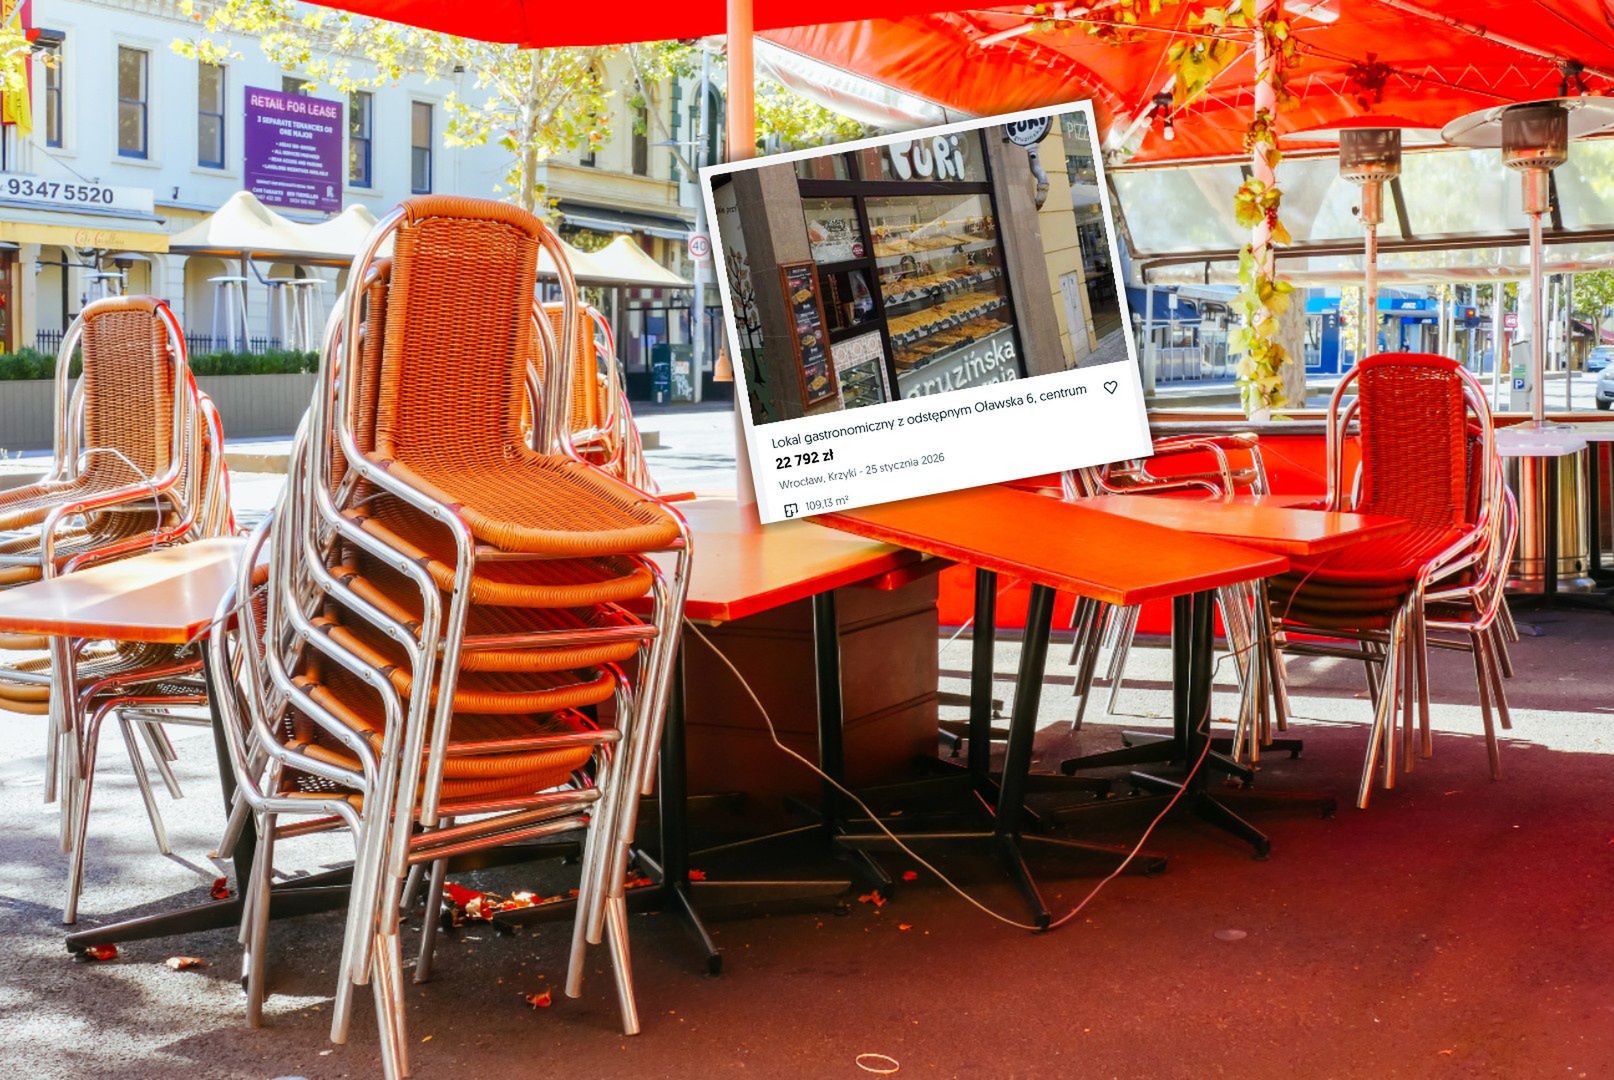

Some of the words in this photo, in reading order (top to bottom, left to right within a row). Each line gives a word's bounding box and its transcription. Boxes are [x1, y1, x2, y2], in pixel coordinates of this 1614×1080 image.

[250, 94, 285, 110] RETAIL
[287, 101, 306, 114] FOR
[308, 104, 337, 118] LEASE
[262, 116, 292, 128] SEPARATE
[293, 130, 313, 140] MAJOR
[692, 240, 705, 251] 40
